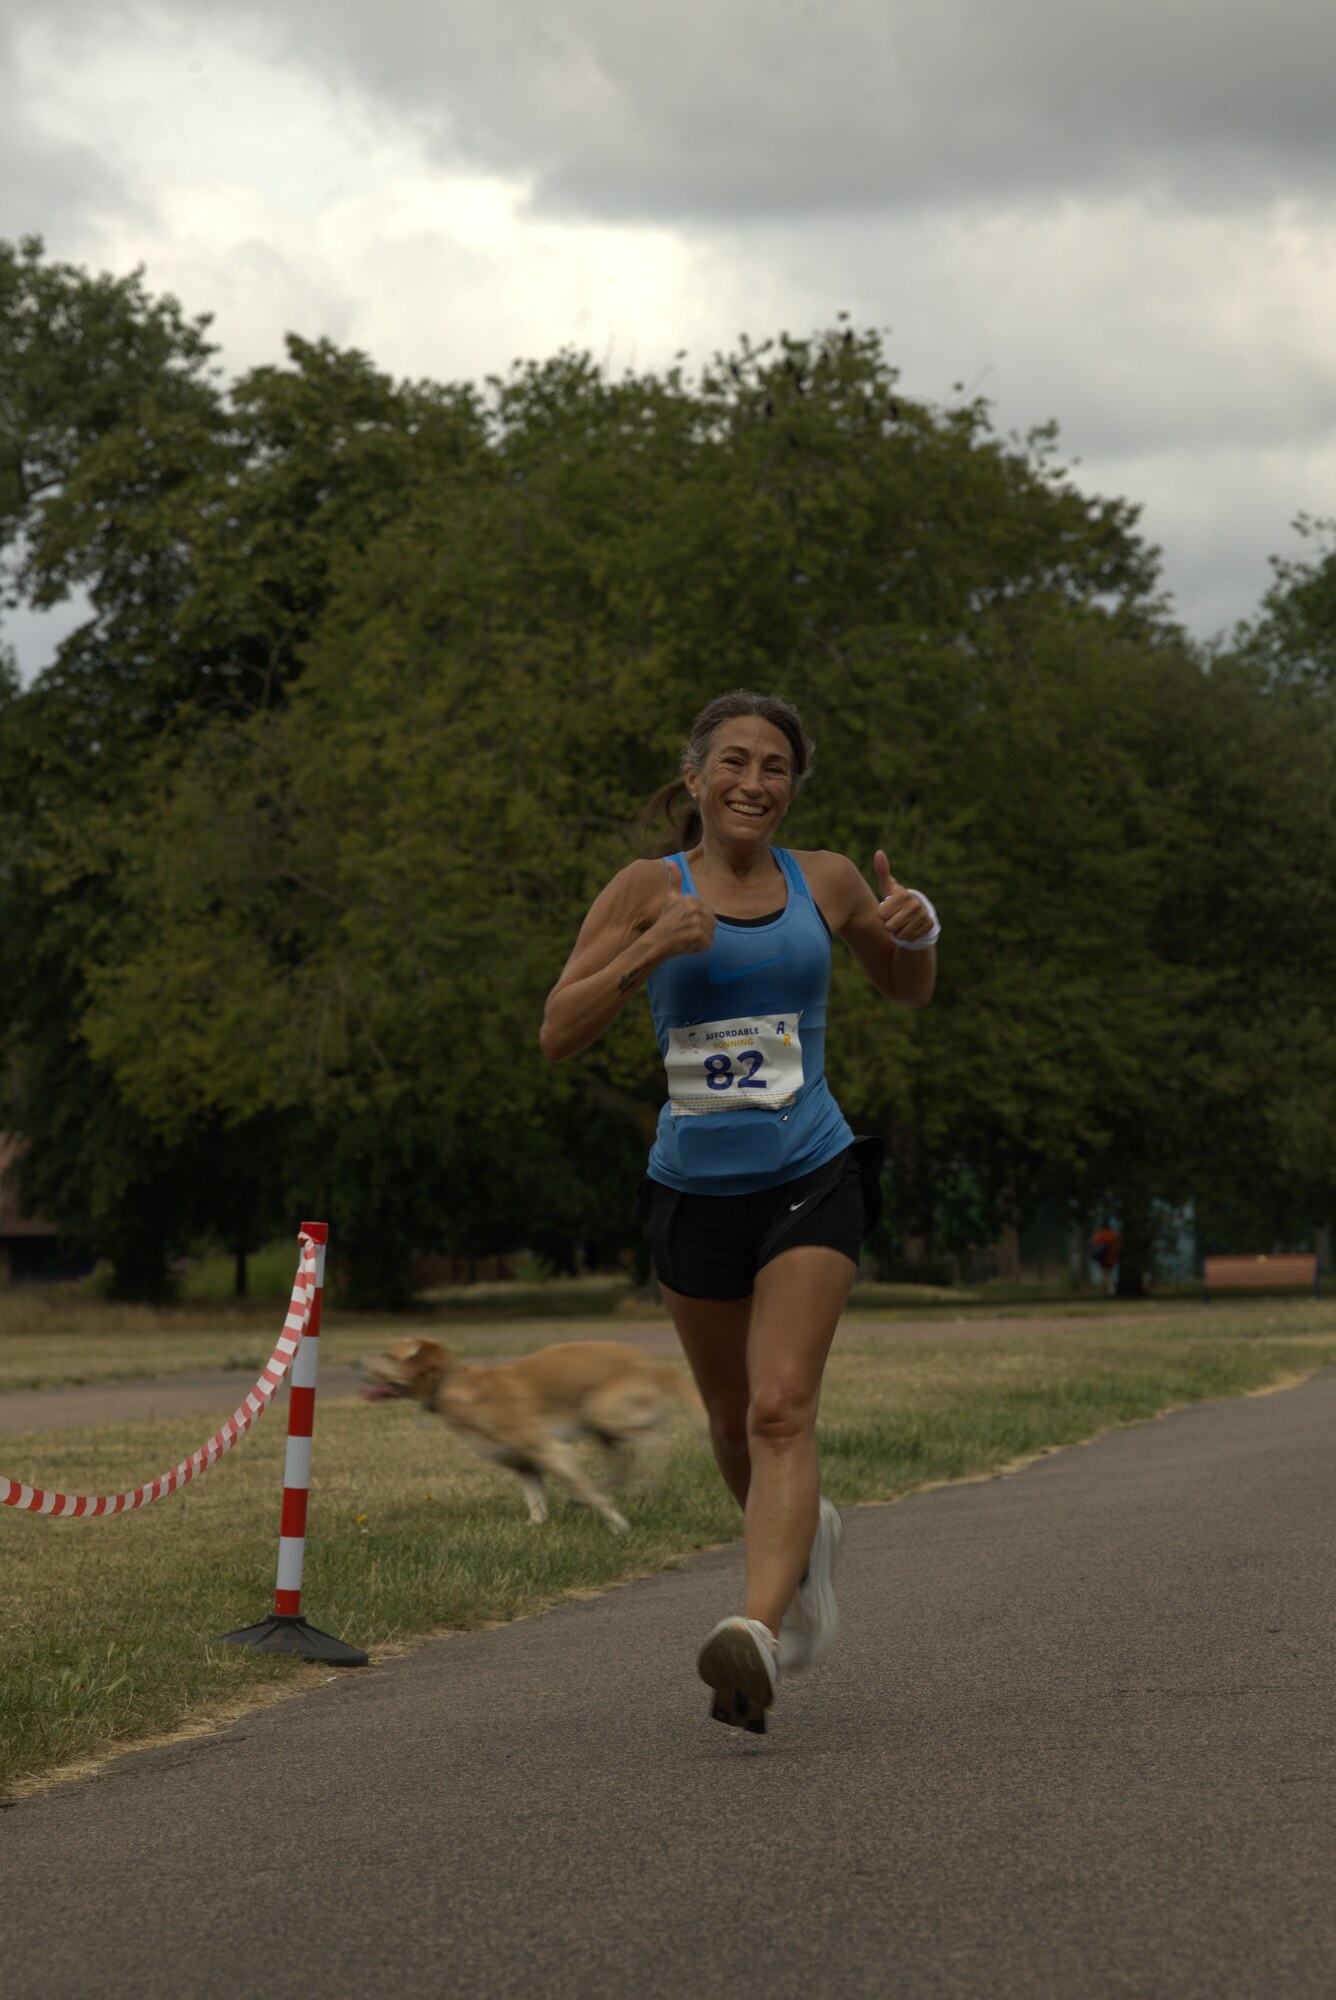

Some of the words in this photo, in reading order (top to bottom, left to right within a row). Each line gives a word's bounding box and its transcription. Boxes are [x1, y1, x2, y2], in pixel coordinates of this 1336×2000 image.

[706, 1027, 759, 1041] AFFORDABLE
[776, 1021, 785, 1035] A
[713, 1038, 754, 1049] RUNNING
[783, 1033, 792, 1047] R
[704, 1050, 767, 1090] 82
